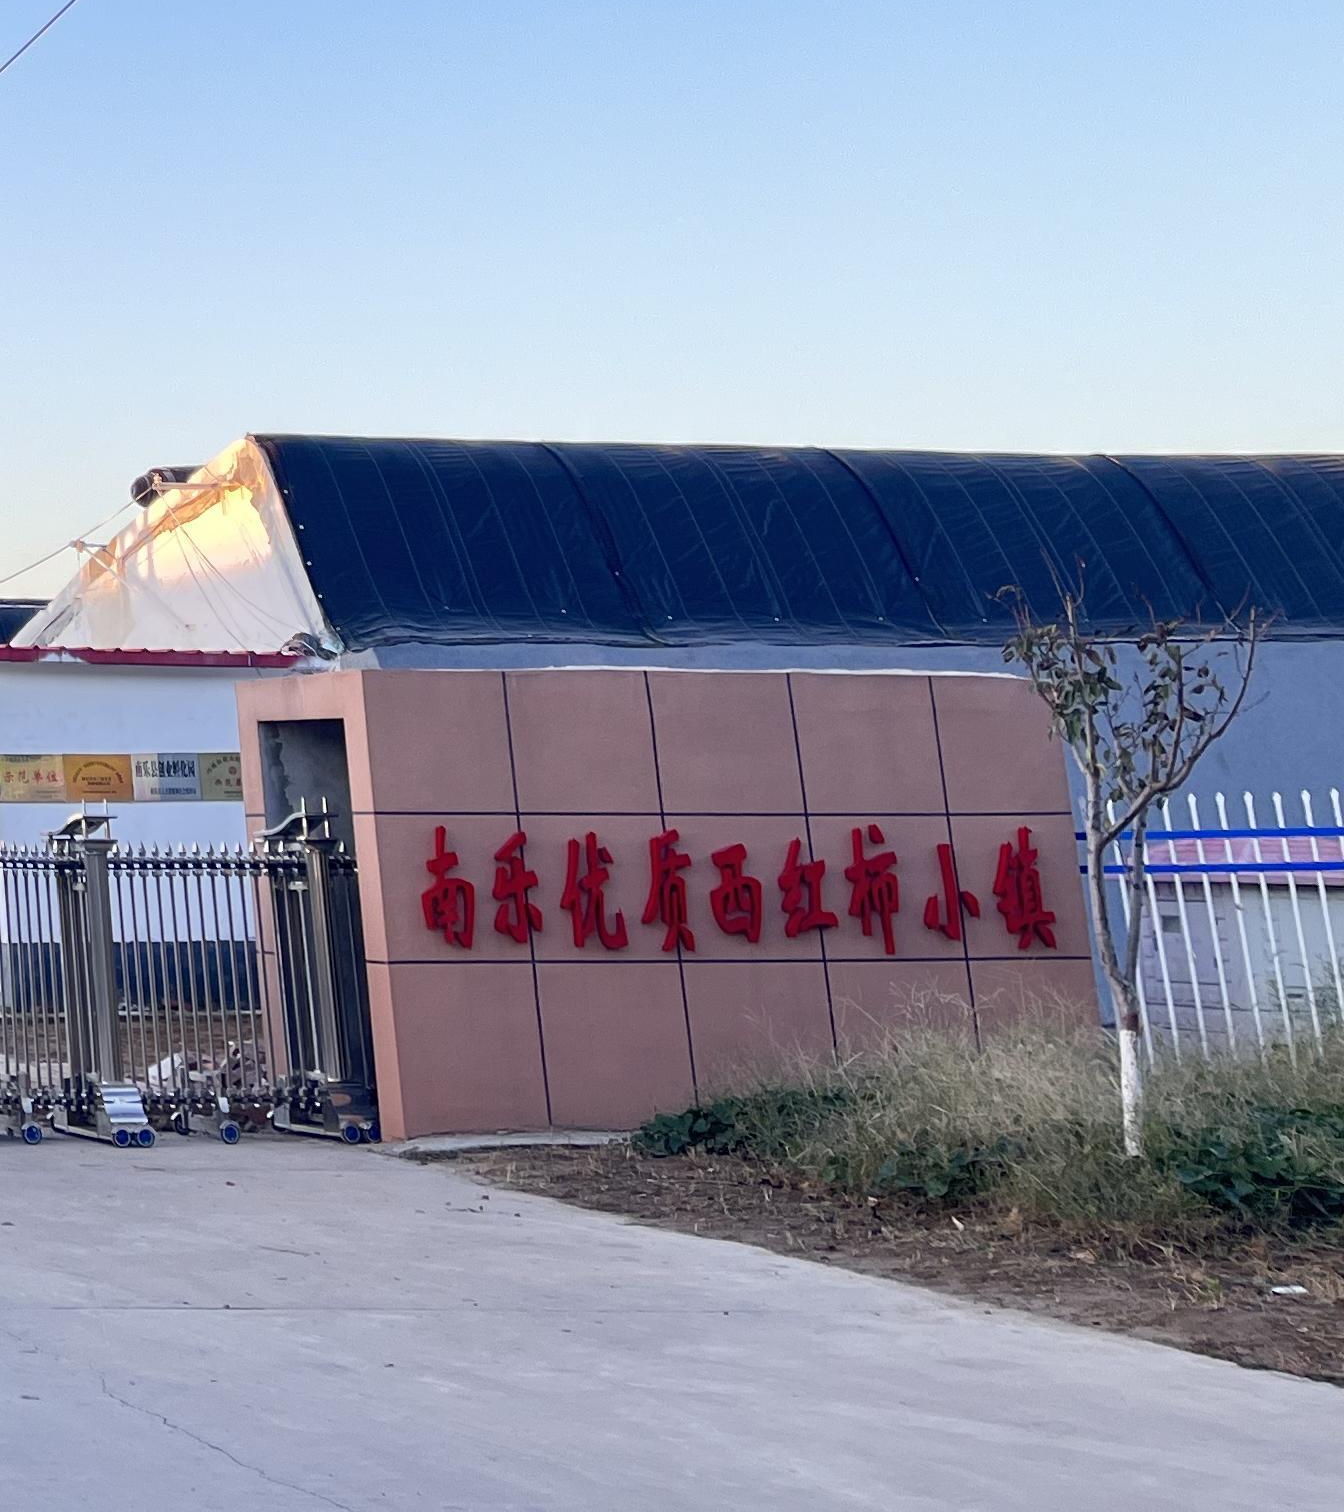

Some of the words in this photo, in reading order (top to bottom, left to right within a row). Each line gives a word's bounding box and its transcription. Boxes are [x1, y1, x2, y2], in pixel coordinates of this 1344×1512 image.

[421, 823, 1057, 955] 南乐优质西红柿小镇
